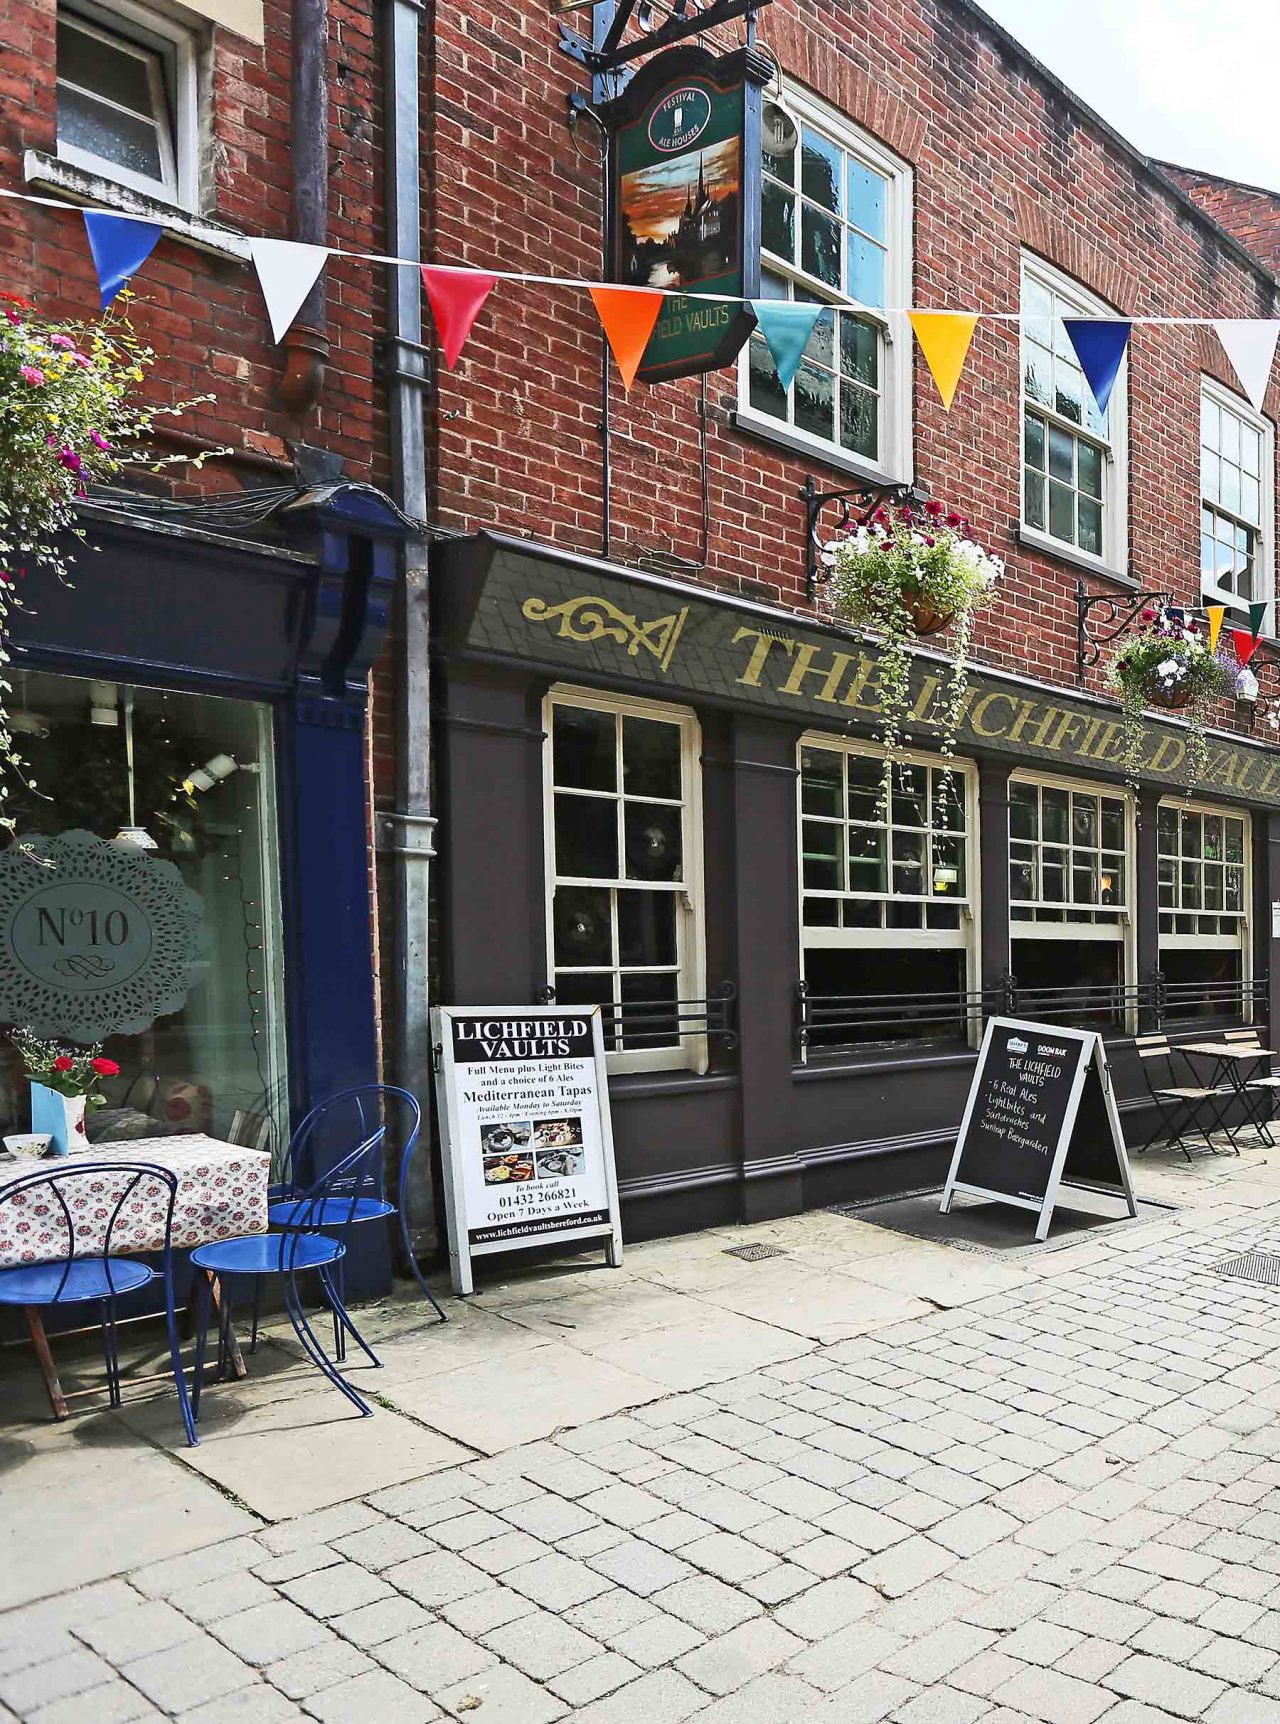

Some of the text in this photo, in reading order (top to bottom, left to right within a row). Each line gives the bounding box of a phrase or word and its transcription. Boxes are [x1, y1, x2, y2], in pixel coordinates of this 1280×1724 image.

[662, 92, 695, 112] FESTIVAL
[686, 304, 729, 332] VAULTS
[731, 626, 884, 713] THE
[456, 1020, 588, 1040] LICHFIELD
[480, 1038, 570, 1058] VAULTS
[468, 1062, 584, 1076] Full Menu plus Light Bites
[1009, 1057, 1061, 1078] THE LICHFIELD
[481, 1077, 497, 1086] and
[508, 1075, 536, 1085] choice
[538, 1075, 548, 1083] of
[556, 1074, 574, 1082] Ales
[1019, 1072, 1045, 1087] VAULTS
[463, 1085, 592, 1103] Mediterranean Tapas
[1000, 1081, 1017, 1096] Real
[1020, 1088, 1038, 1104] Ales
[478, 1103, 511, 1113] Available
[513, 1101, 541, 1111] Monday
[551, 1099, 583, 1108] Saturday
[1029, 1112, 1047, 1124] and
[1007, 1127, 1048, 1155] Beergarden
[526, 1182, 544, 1191] book
[546, 1181, 559, 1189] call
[499, 1188, 576, 1208] 01432 266821
[487, 1211, 515, 1222] Open
[518, 1208, 524, 1216] 7
[528, 1205, 551, 1216] Days
[563, 1199, 589, 1209] Week
[475, 1214, 603, 1241] www.lichfieldvaultshereford.co.uk
